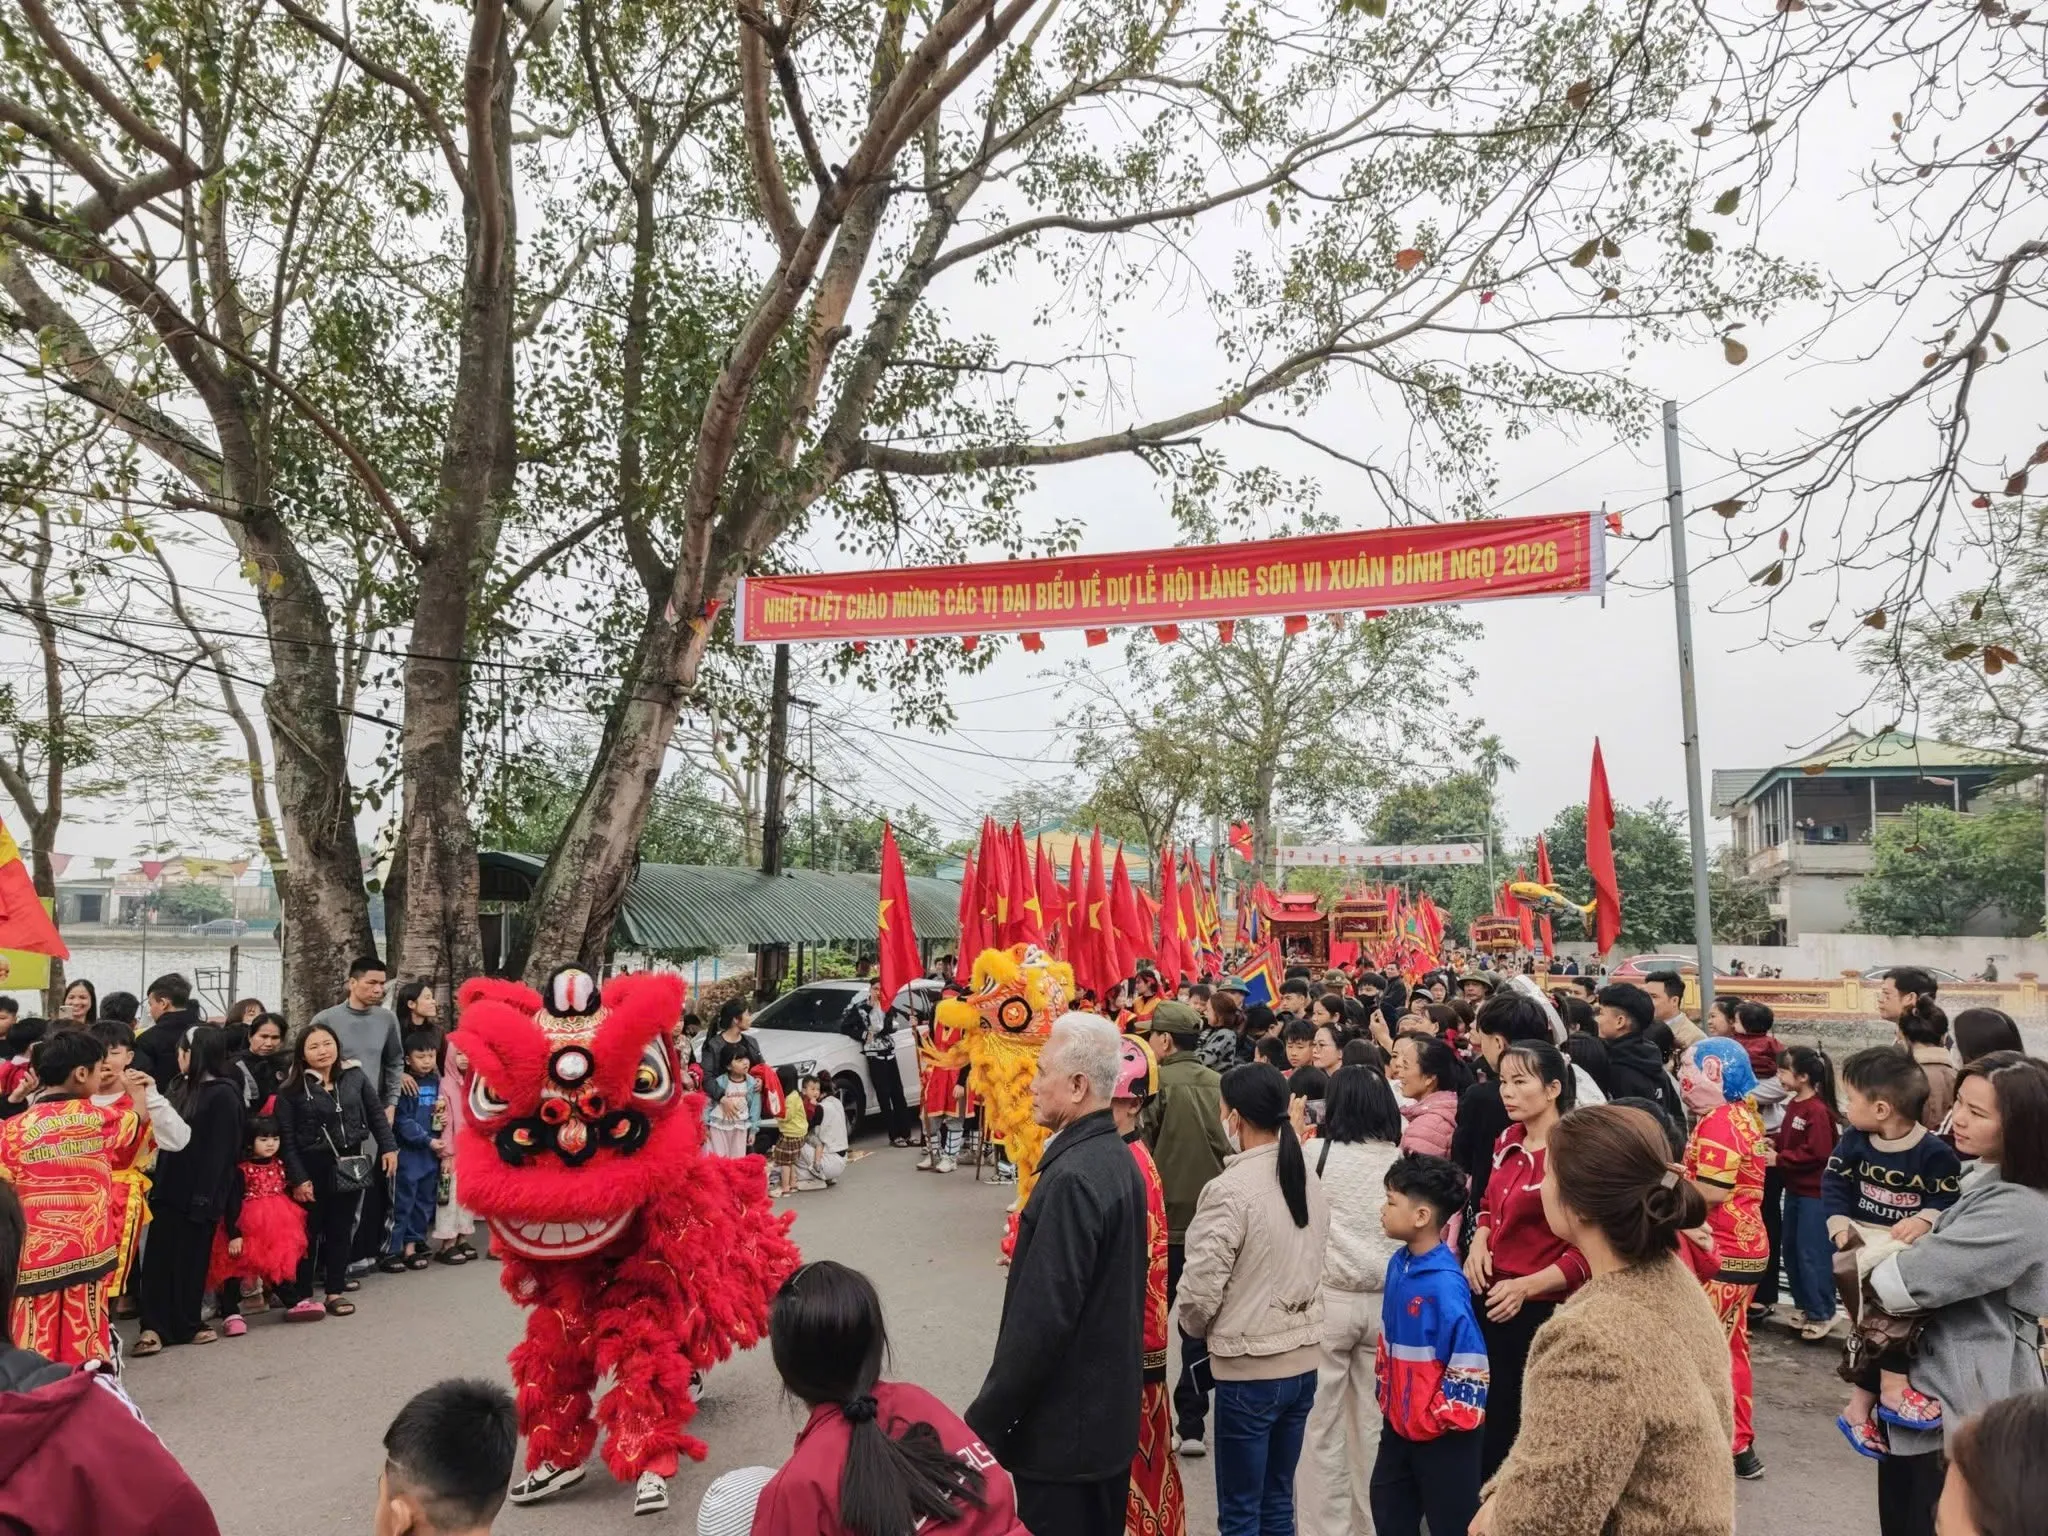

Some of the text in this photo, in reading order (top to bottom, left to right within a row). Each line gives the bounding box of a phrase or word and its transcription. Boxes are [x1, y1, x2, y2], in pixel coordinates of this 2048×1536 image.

[763, 540, 1558, 628] NHIỆT LIỆT CHÀO MỪNG CÁC VỊ ĐẠI BIỂU VỀ DỰ LỄ HỘI LÀNG SƠN VI XUÂN BÍNH NGỌ 2026
[1863, 1183, 1919, 1206] EST 1919
